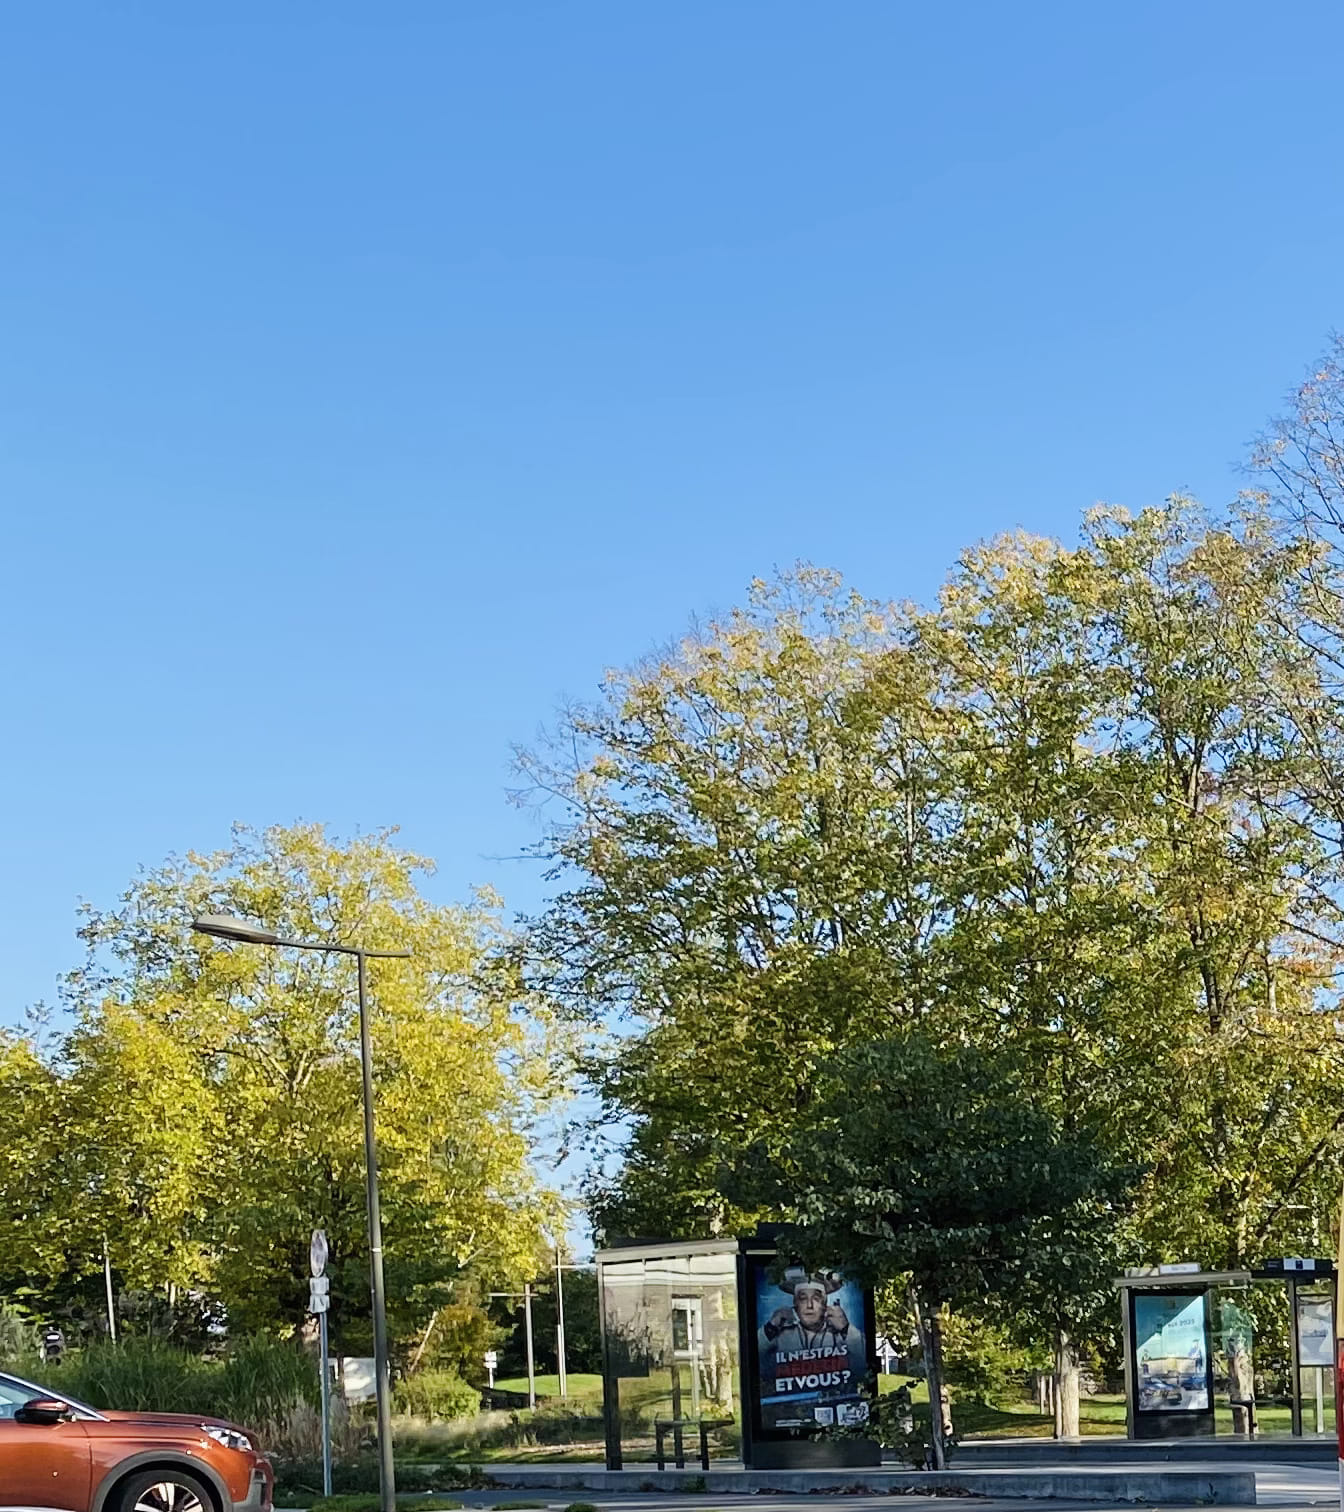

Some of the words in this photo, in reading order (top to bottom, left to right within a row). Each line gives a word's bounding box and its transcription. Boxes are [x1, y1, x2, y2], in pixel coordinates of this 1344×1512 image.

[776, 1352, 787, 1363] IL
[788, 1347, 823, 1362] N'EST
[823, 1344, 848, 1358] PAS
[775, 1377, 794, 1392] ET
[795, 1371, 841, 1390] VOUS
